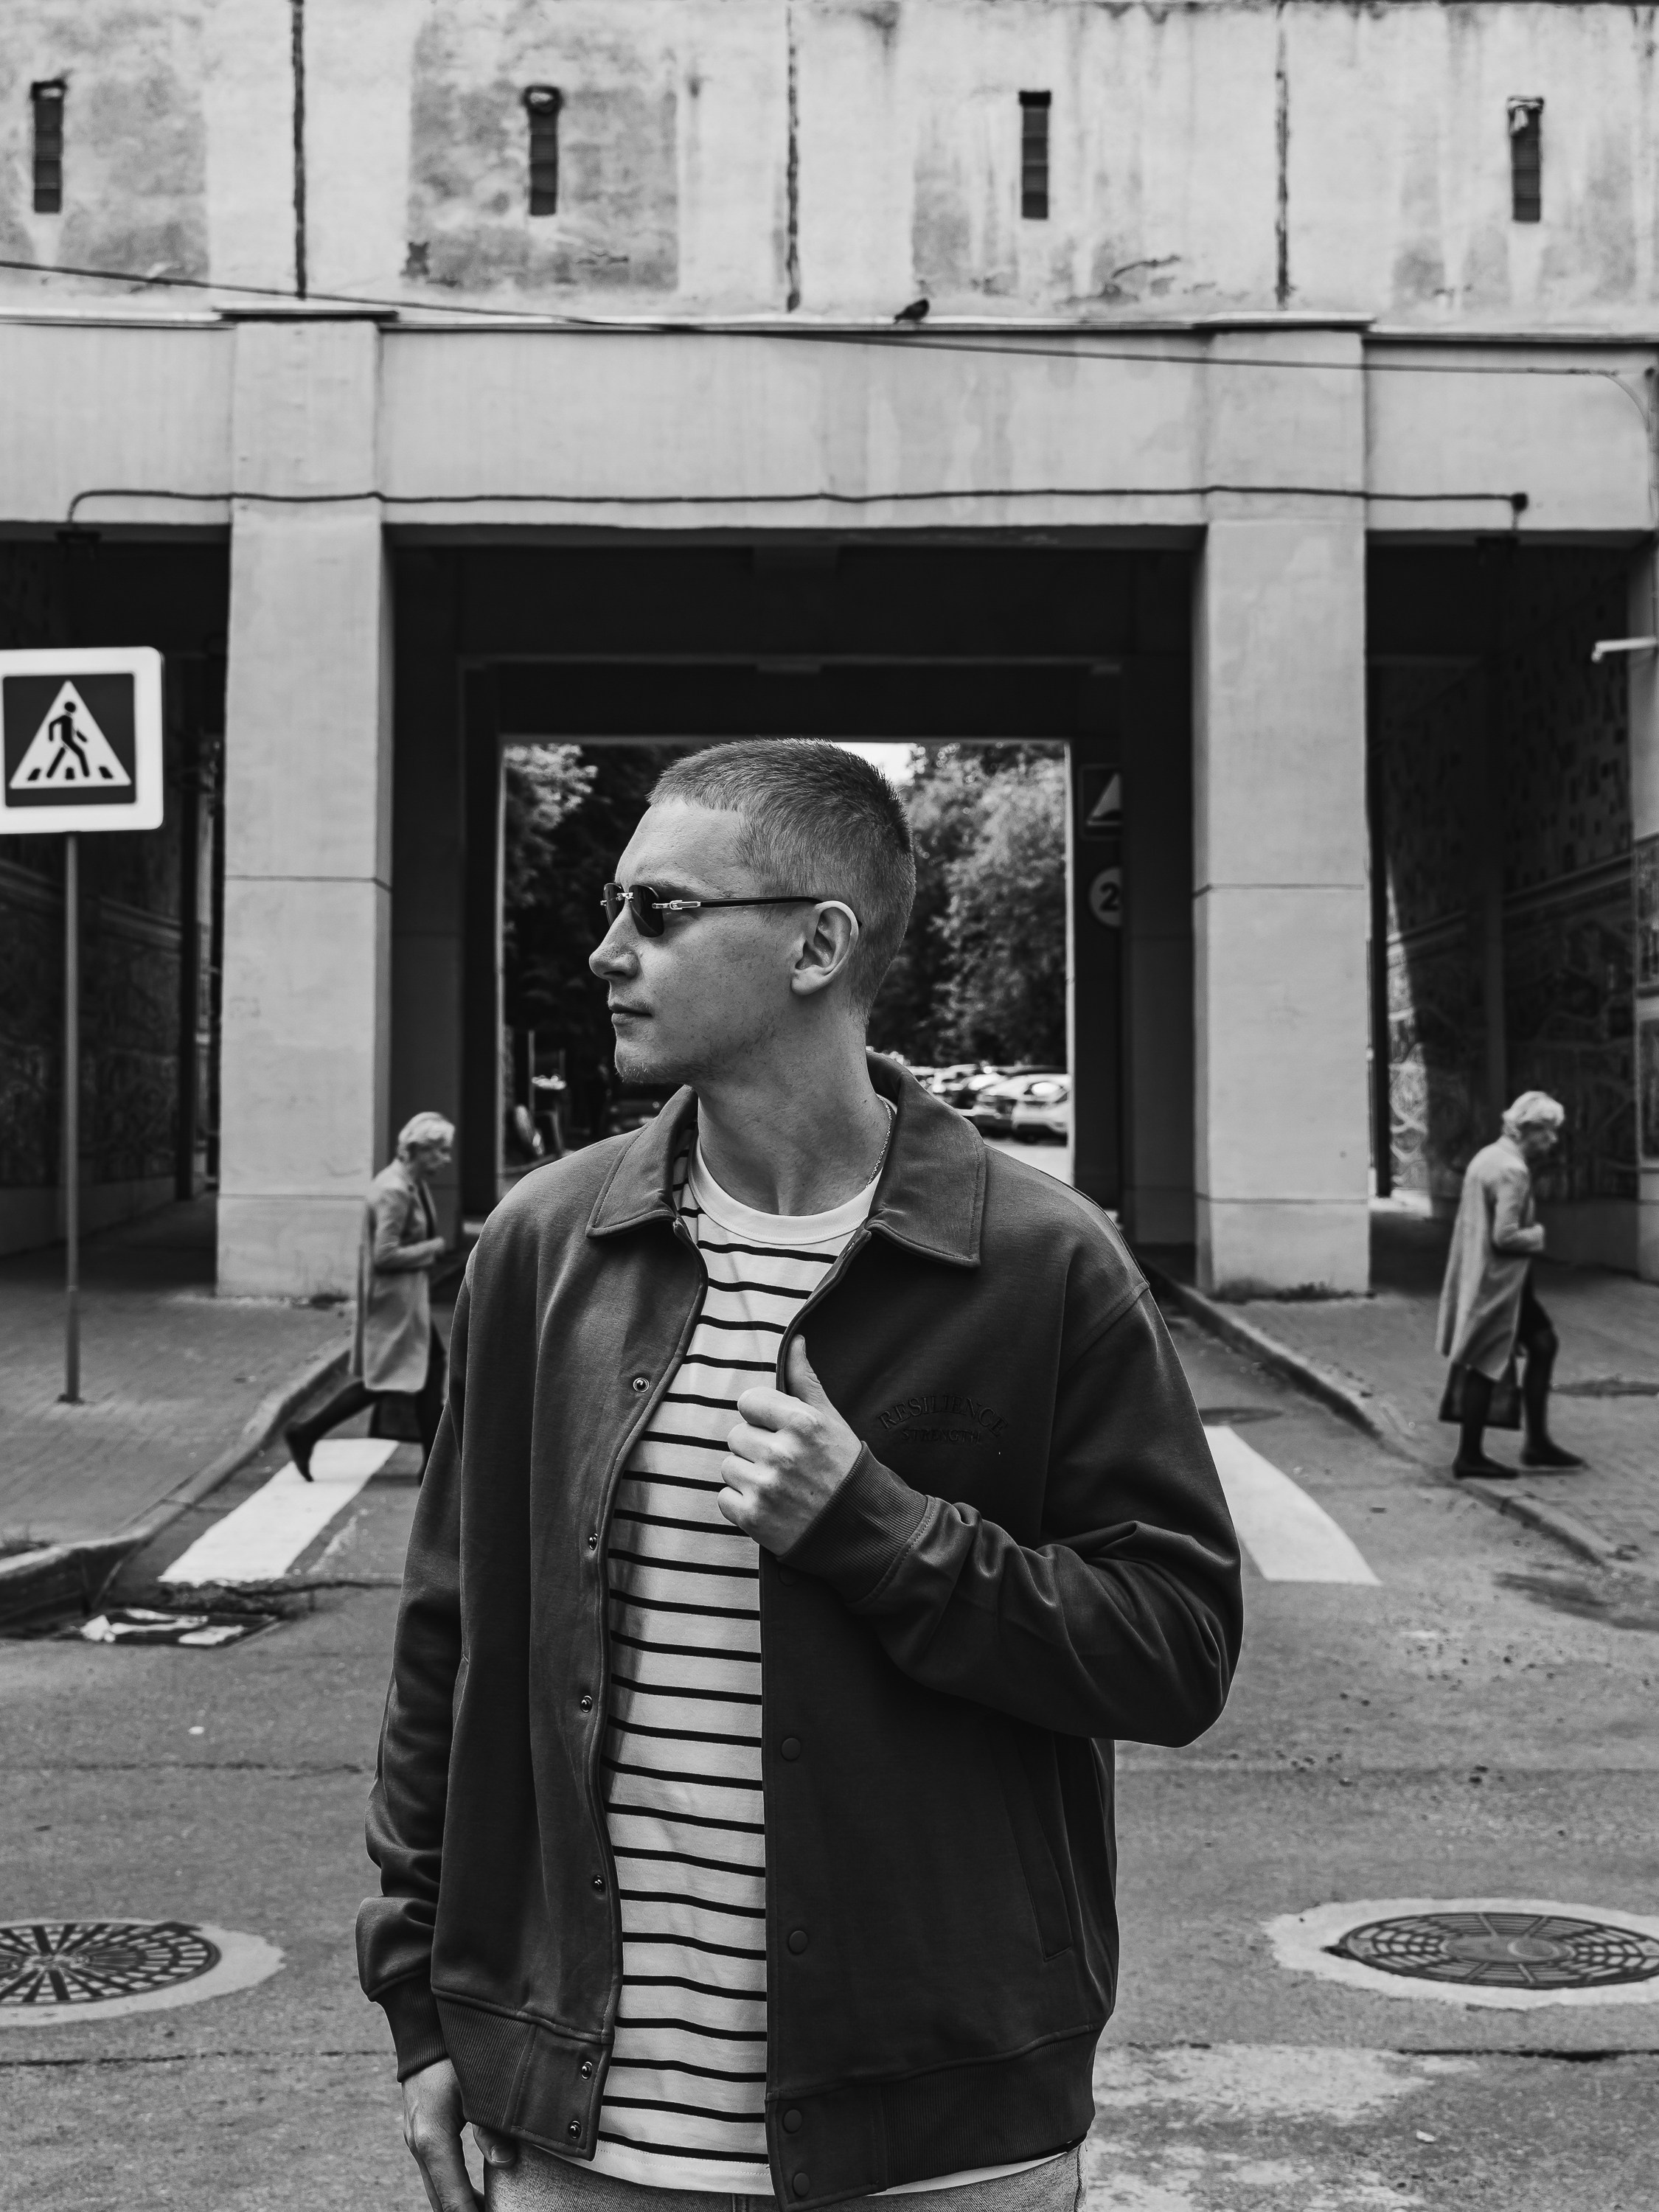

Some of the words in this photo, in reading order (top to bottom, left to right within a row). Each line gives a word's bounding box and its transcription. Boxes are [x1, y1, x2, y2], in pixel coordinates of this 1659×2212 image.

[1099, 881, 1119, 911] 2
[877, 1394, 1008, 1437] RESILIENCE
[900, 1427, 982, 1445] STRENGTH
